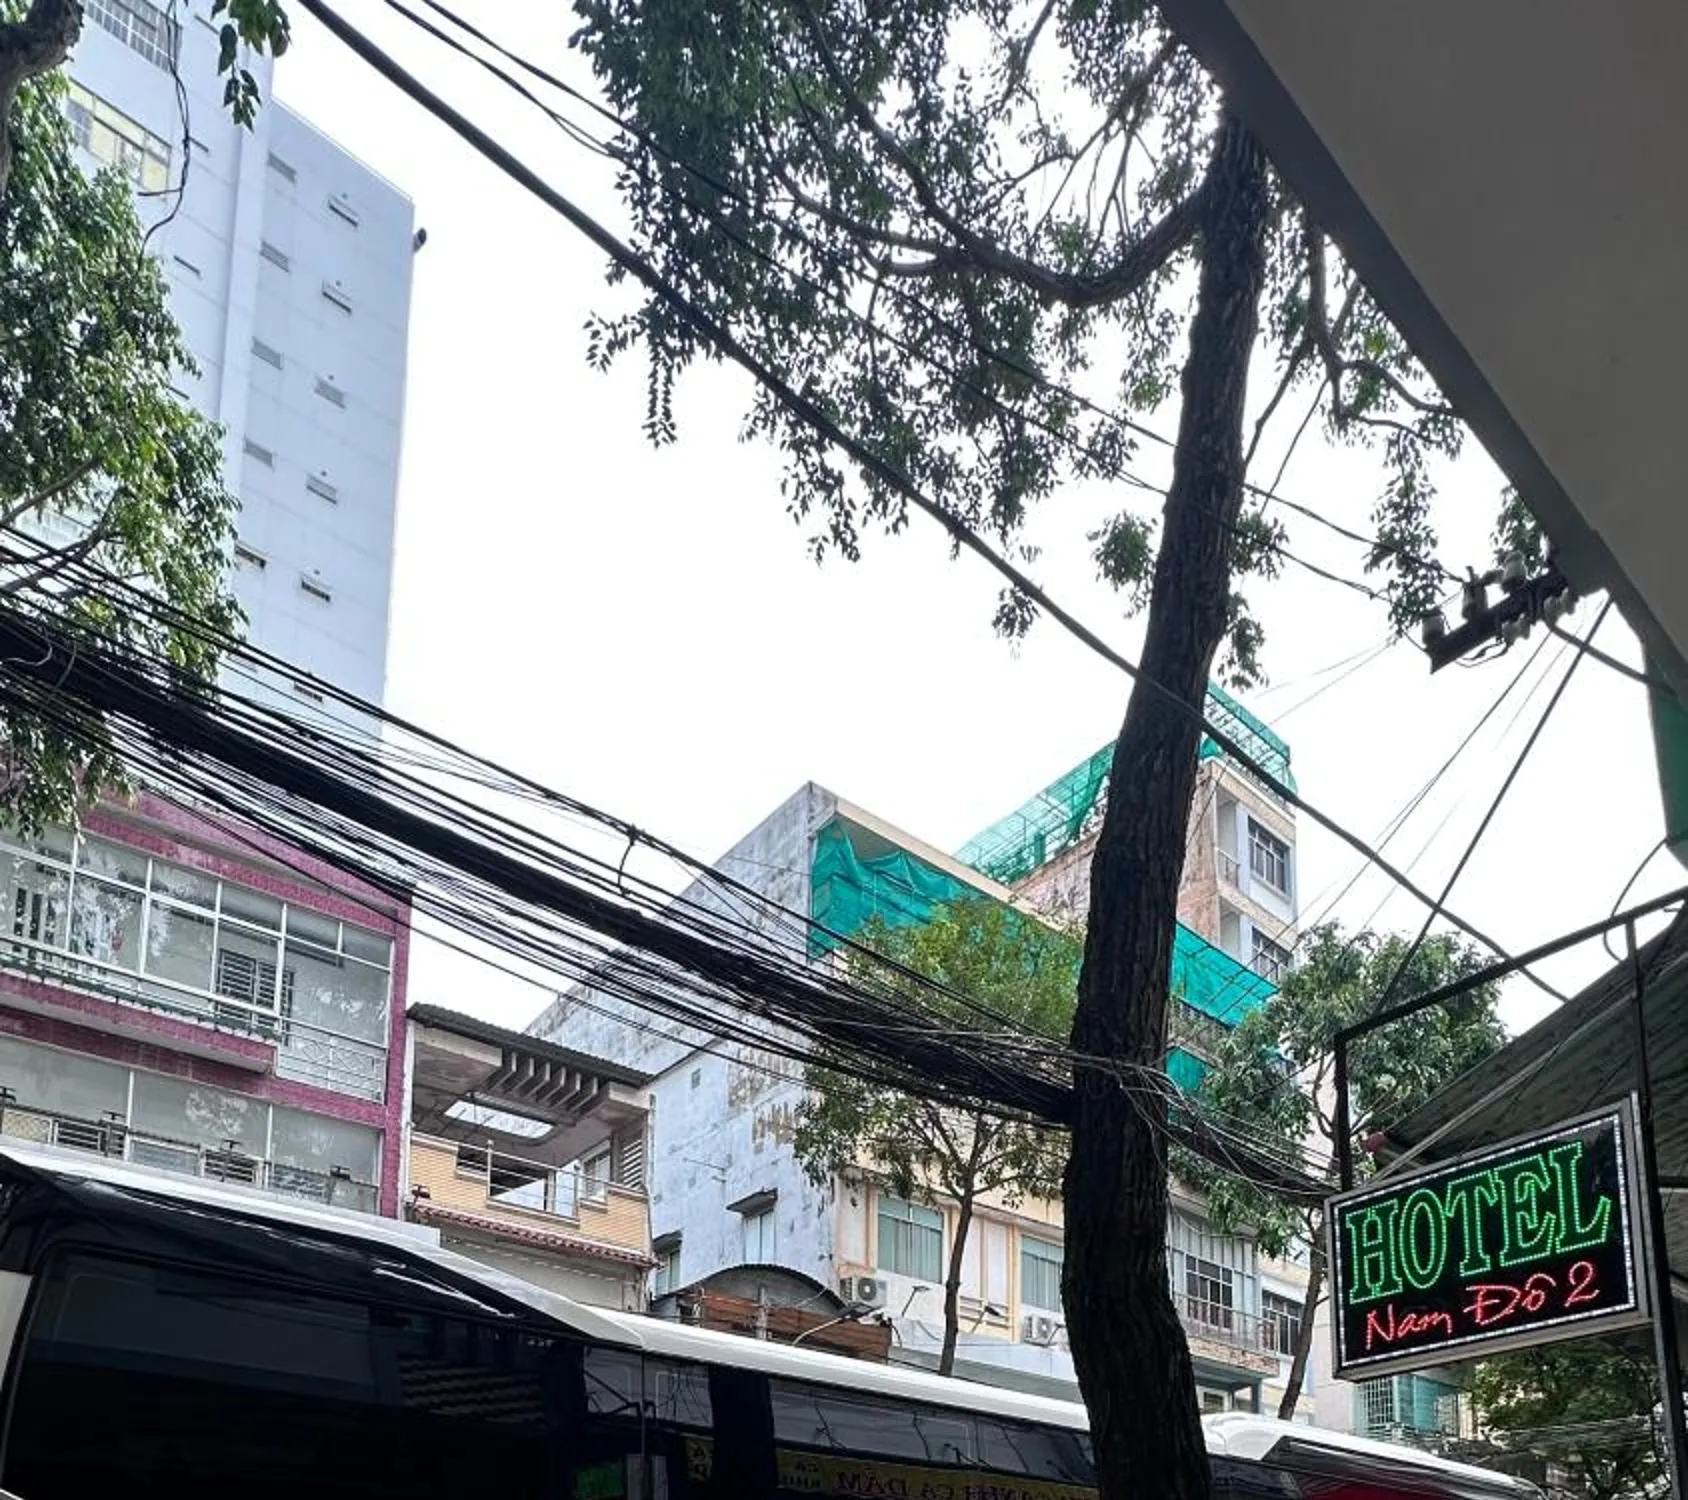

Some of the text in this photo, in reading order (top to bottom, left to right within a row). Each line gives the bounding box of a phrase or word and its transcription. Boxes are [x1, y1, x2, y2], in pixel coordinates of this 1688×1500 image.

[1346, 1141, 1612, 1304] HOTEL
[1366, 1304, 1452, 1350] Nam
[1564, 1261, 1600, 1307] 2
